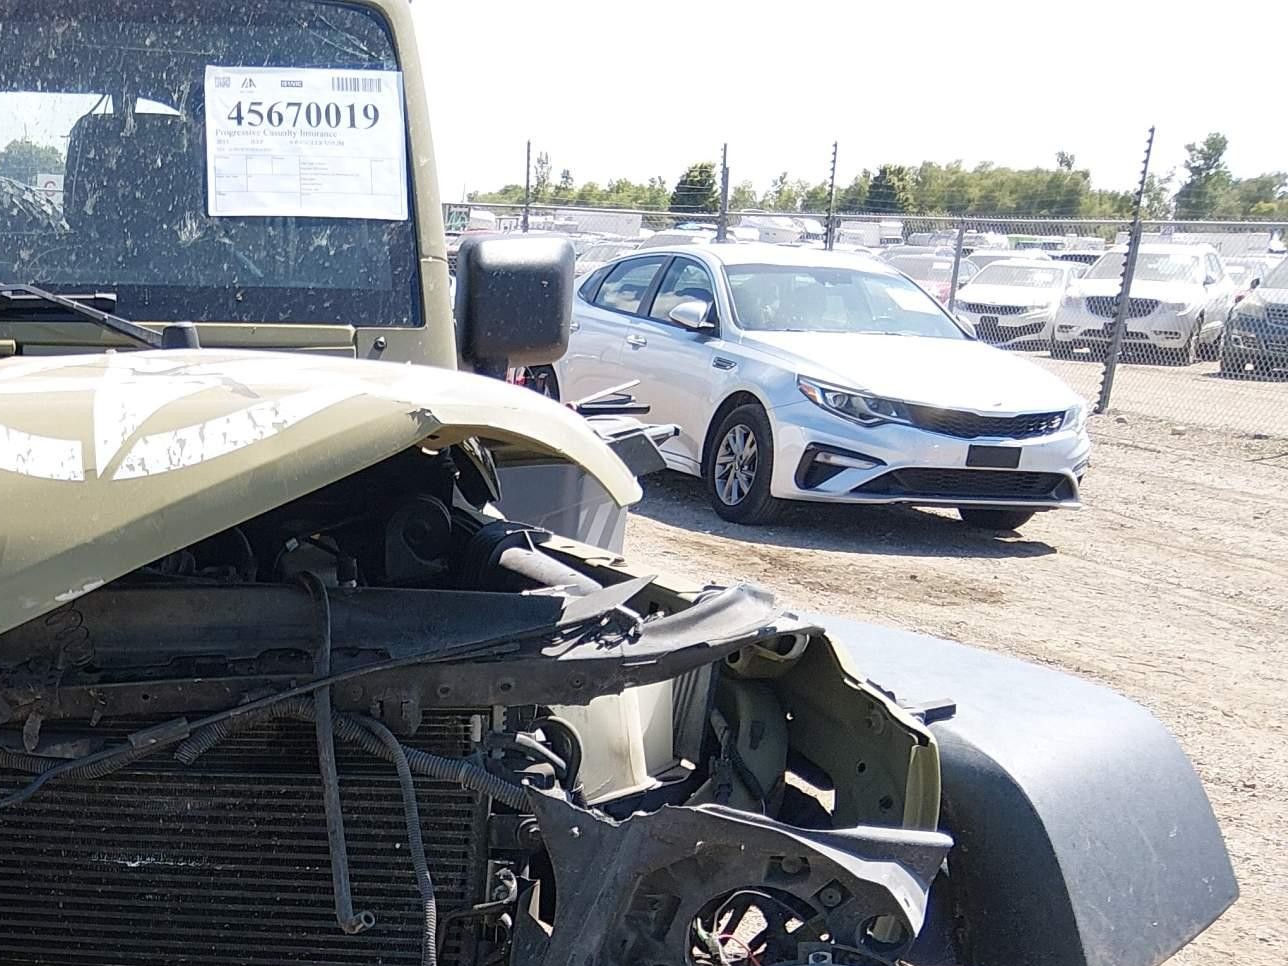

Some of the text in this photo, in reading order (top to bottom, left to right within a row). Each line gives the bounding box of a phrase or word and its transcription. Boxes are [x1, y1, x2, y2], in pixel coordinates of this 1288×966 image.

[227, 101, 380, 130] 45670019
[215, 129, 337, 139] Progressive Casualty Insurance
